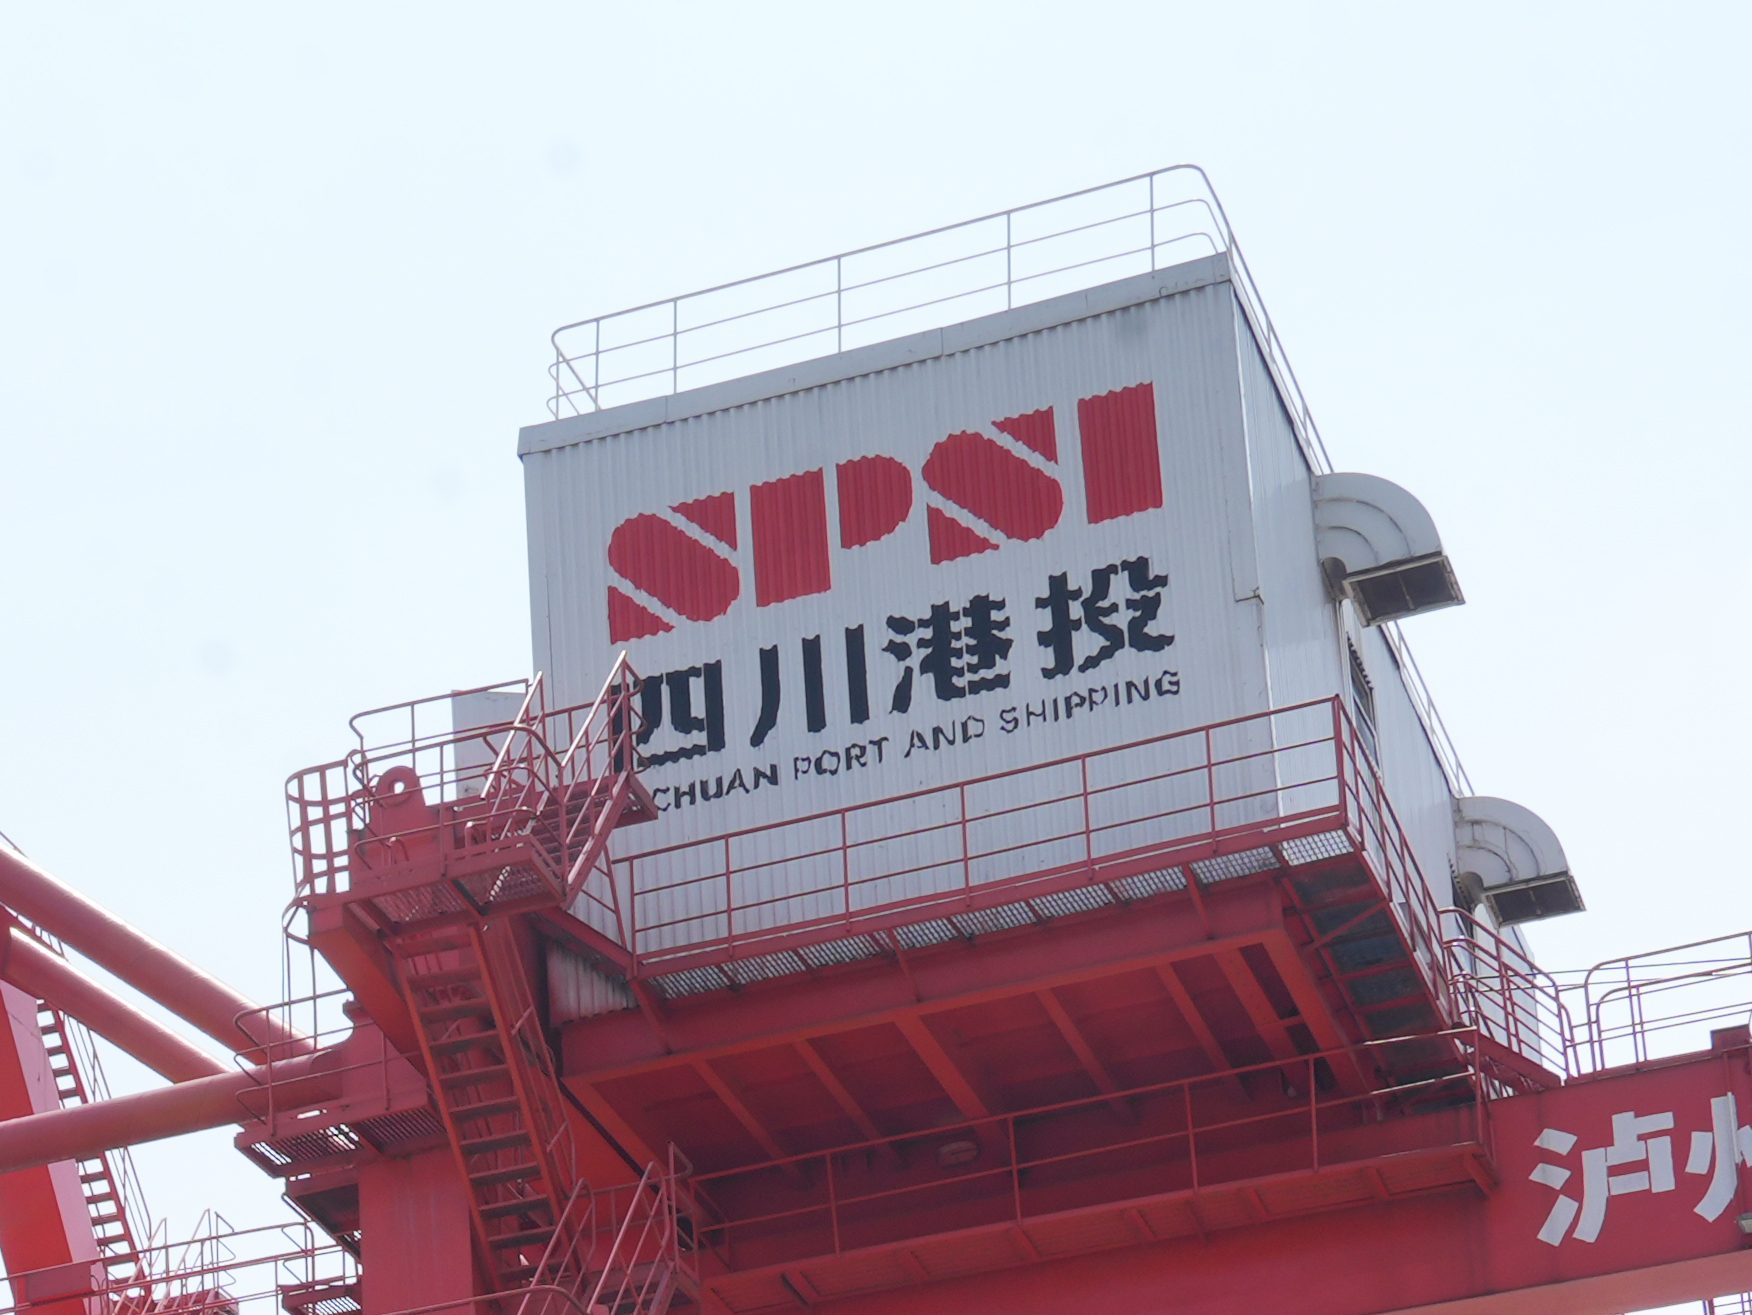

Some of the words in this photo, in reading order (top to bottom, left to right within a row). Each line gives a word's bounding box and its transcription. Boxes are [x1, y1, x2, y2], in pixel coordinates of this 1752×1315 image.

[607, 381, 1163, 645] SPSI
[612, 555, 1176, 777] 四川港投
[651, 763, 779, 813] CHUAN
[793, 737, 889, 780] PORT
[903, 714, 985, 757] AND
[999, 669, 1182, 735] SHIPPING
